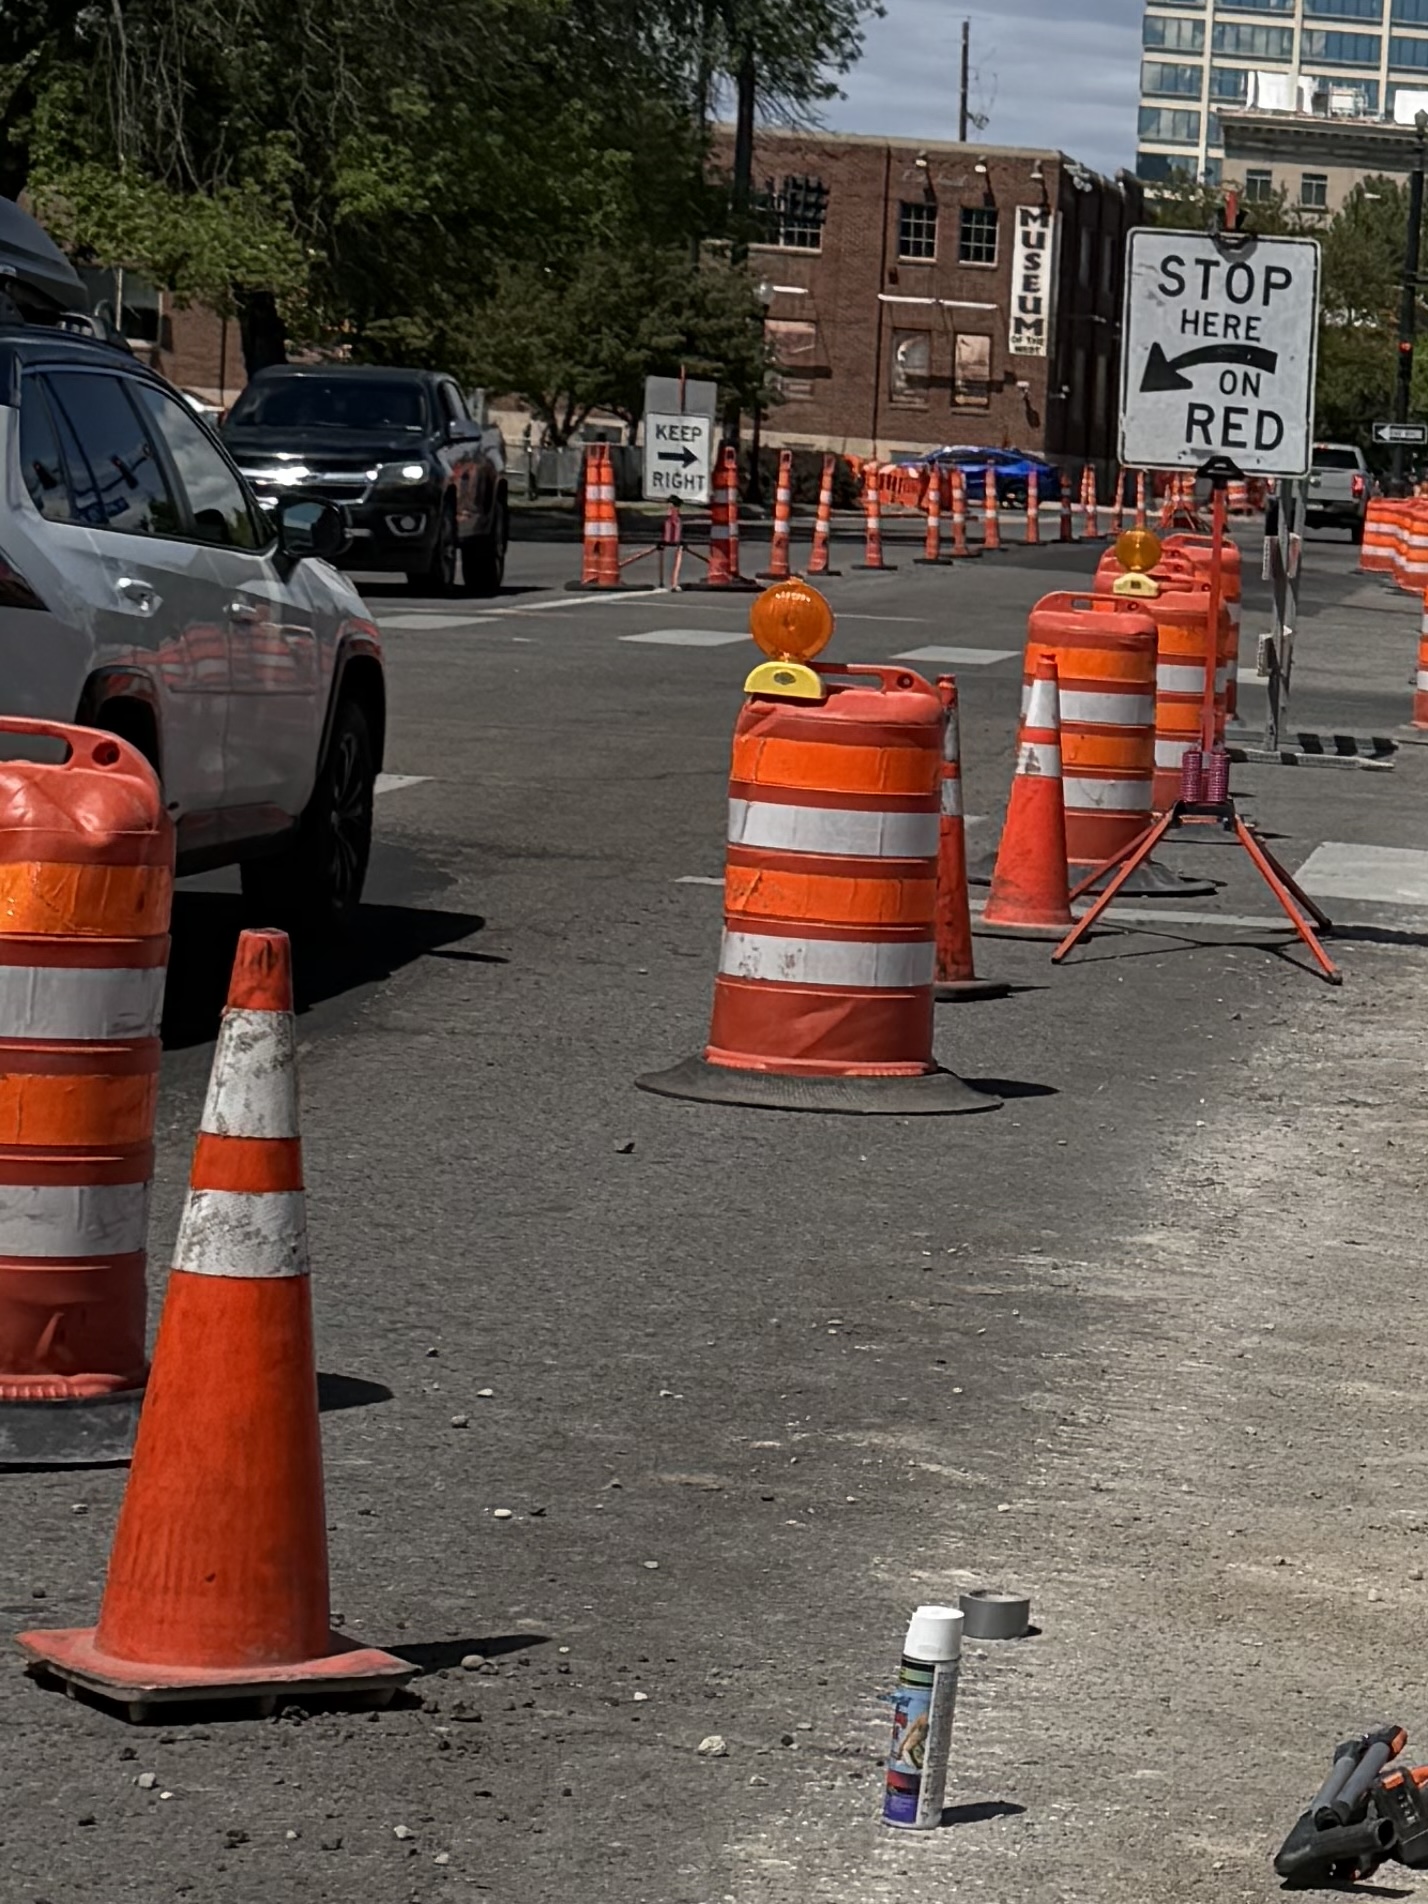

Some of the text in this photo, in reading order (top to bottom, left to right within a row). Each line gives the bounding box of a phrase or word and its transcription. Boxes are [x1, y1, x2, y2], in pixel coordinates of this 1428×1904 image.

[1013, 208, 1049, 336] MUSEUM
[1158, 254, 1293, 306] STOP
[1181, 308, 1262, 342] HERE
[1219, 369, 1261, 398] ON
[656, 424, 702, 442] KEEP
[1185, 402, 1284, 451] RED
[653, 471, 705, 491] RIGHT
